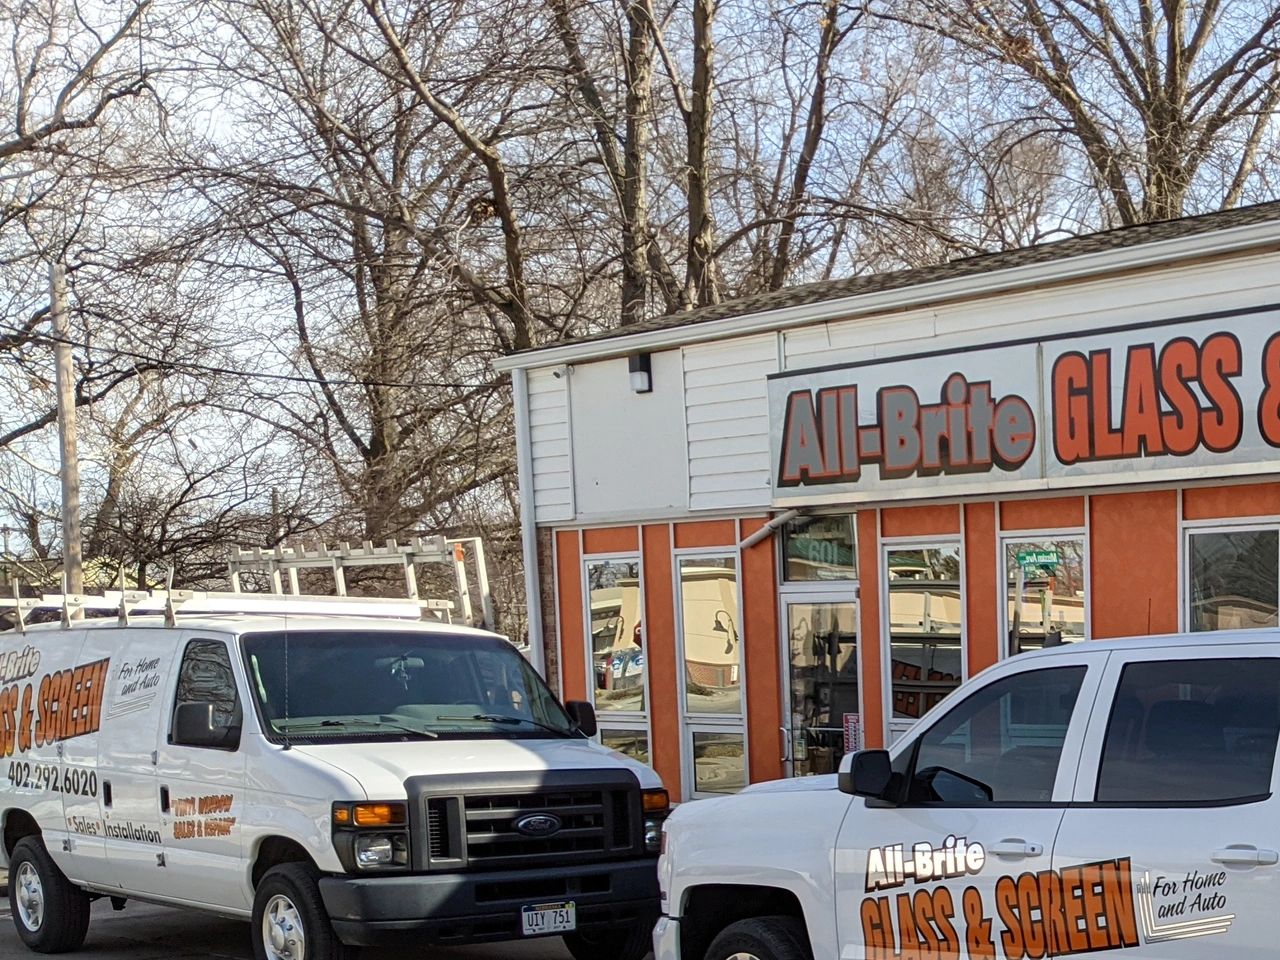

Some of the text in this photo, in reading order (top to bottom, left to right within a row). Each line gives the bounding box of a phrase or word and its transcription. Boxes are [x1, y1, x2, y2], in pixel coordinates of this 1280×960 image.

[777, 372, 1036, 488] All-Brite
[1051, 331, 1243, 466] GLASS
[118, 657, 160, 680] For Home
[121, 674, 160, 696] and Auto
[35, 657, 111, 748] SCREEN
[8, 761, 98, 797] 402.292.6020
[72, 816, 162, 844] Sales Installation
[864, 833, 986, 893] All-Brite
[1152, 868, 1226, 898] For Home
[552, 909, 571, 924] 751
[1158, 892, 1227, 919] and Auto
